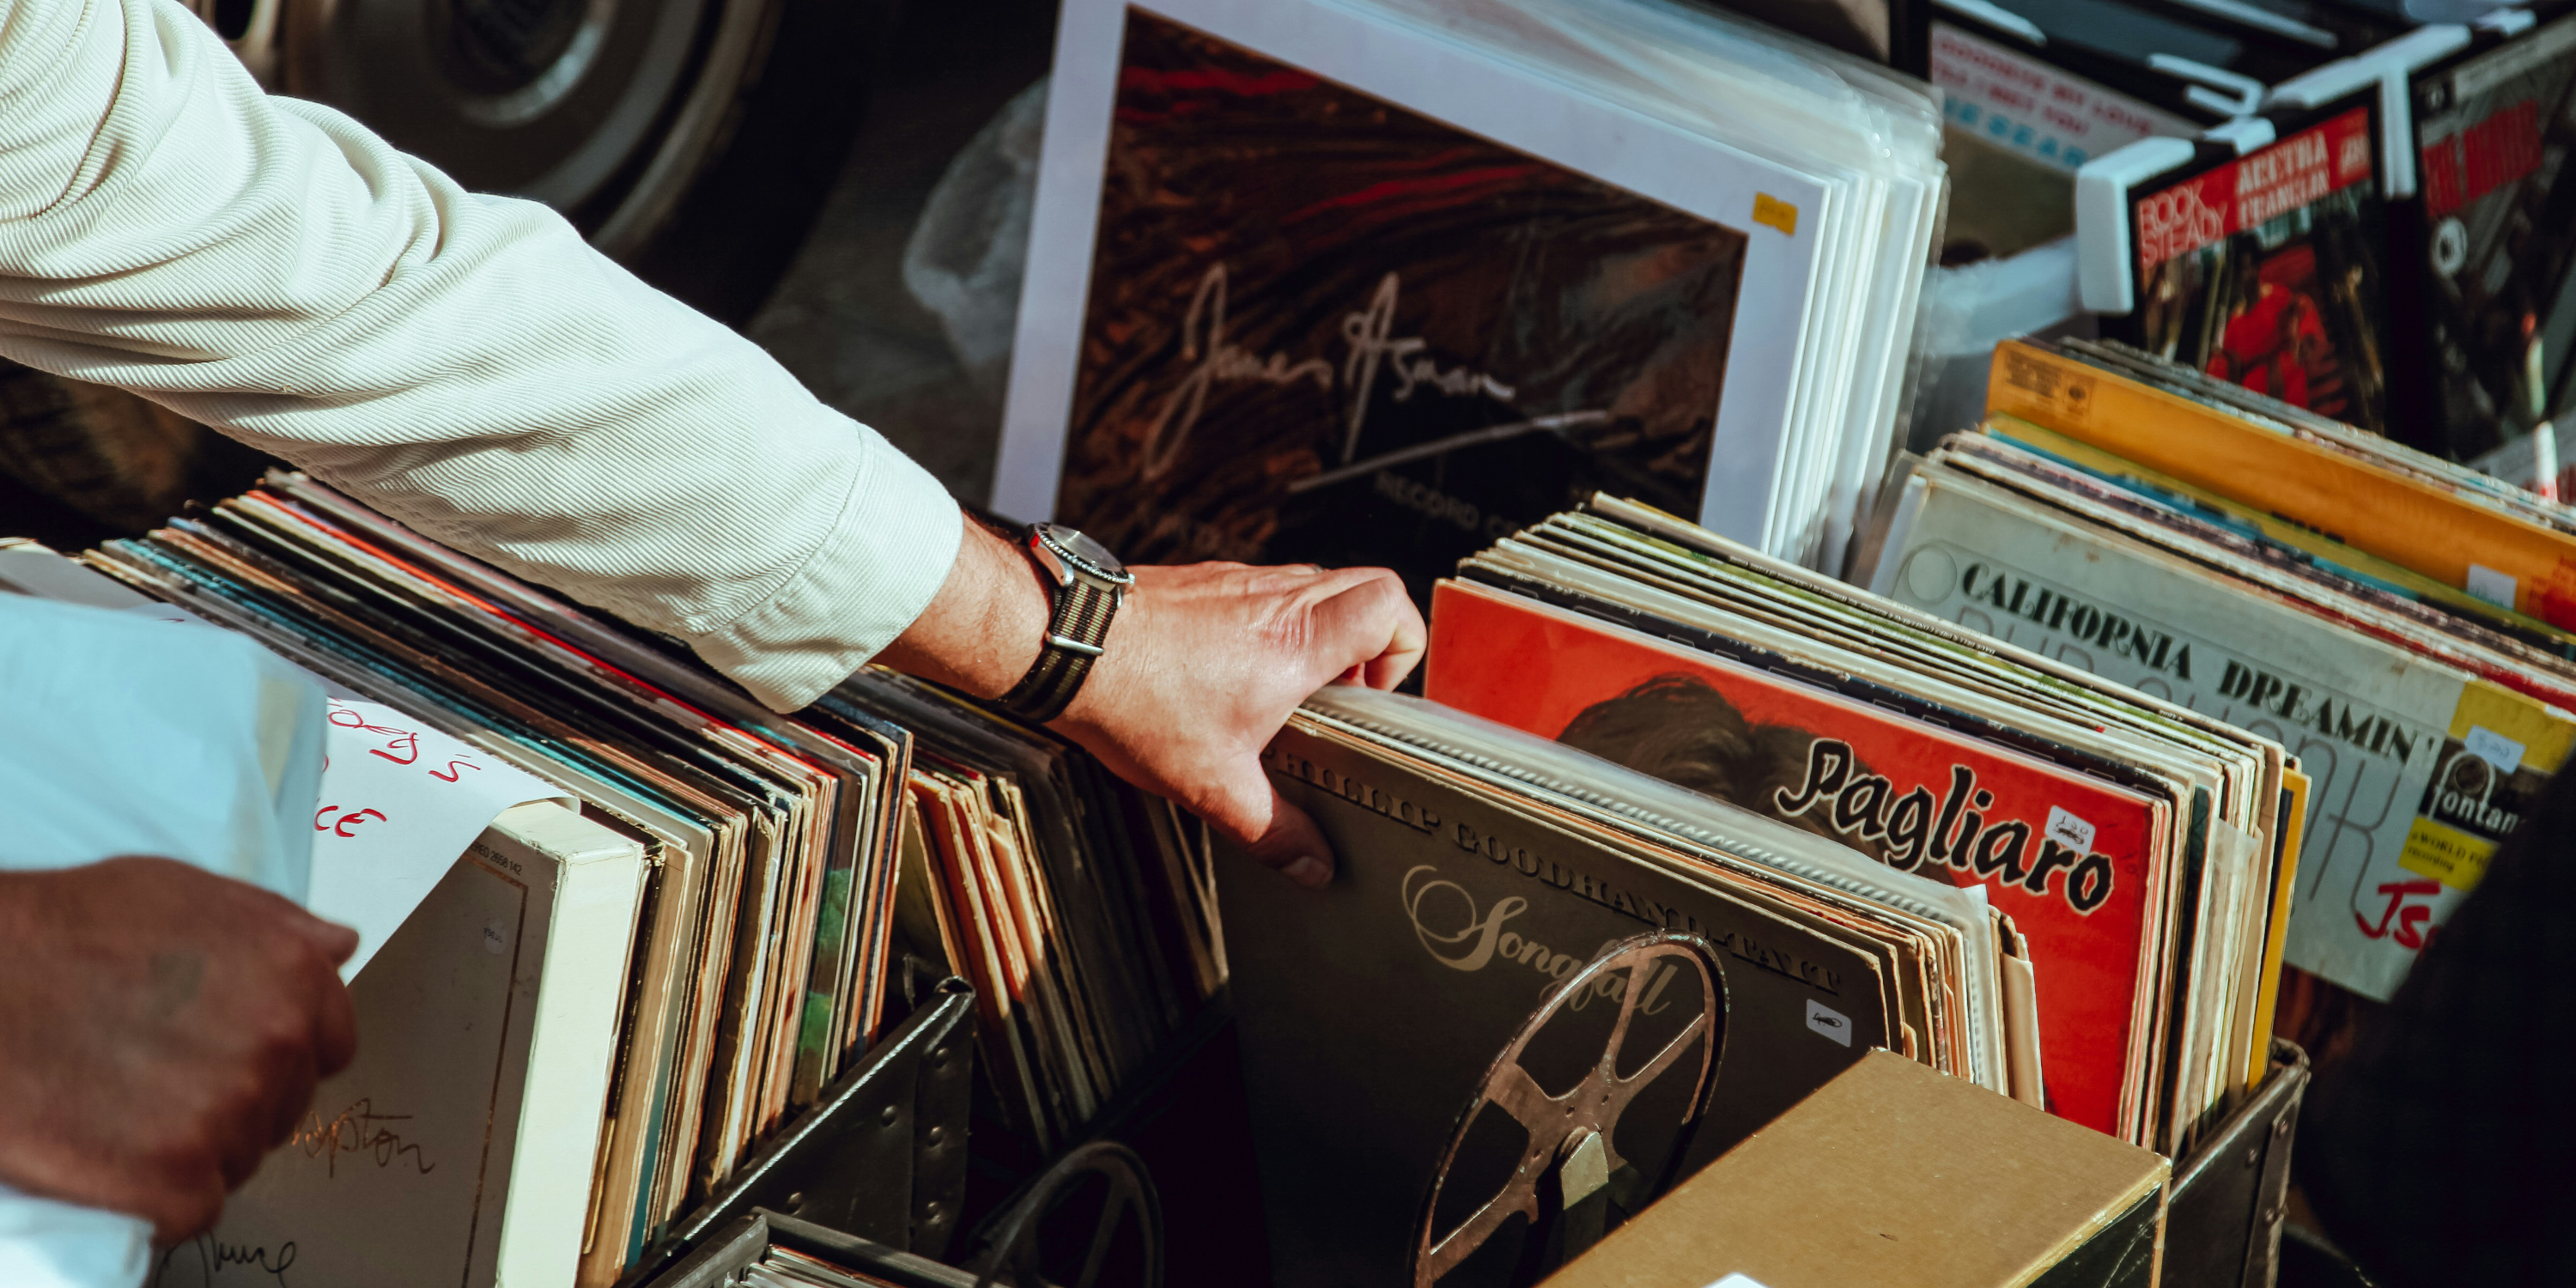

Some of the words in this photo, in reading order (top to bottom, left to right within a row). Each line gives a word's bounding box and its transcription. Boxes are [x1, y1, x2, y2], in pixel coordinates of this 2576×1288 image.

[1374, 470, 1479, 532] RECORD
[1962, 562, 2193, 682] CALIFORNIA
[2217, 657, 2436, 769] DREAMIN'
[1774, 738, 2115, 916] Pagliaro
[2427, 754, 2522, 835] fontan
[509, 861, 522, 876] 142
[2419, 830, 2467, 859] WORLD
